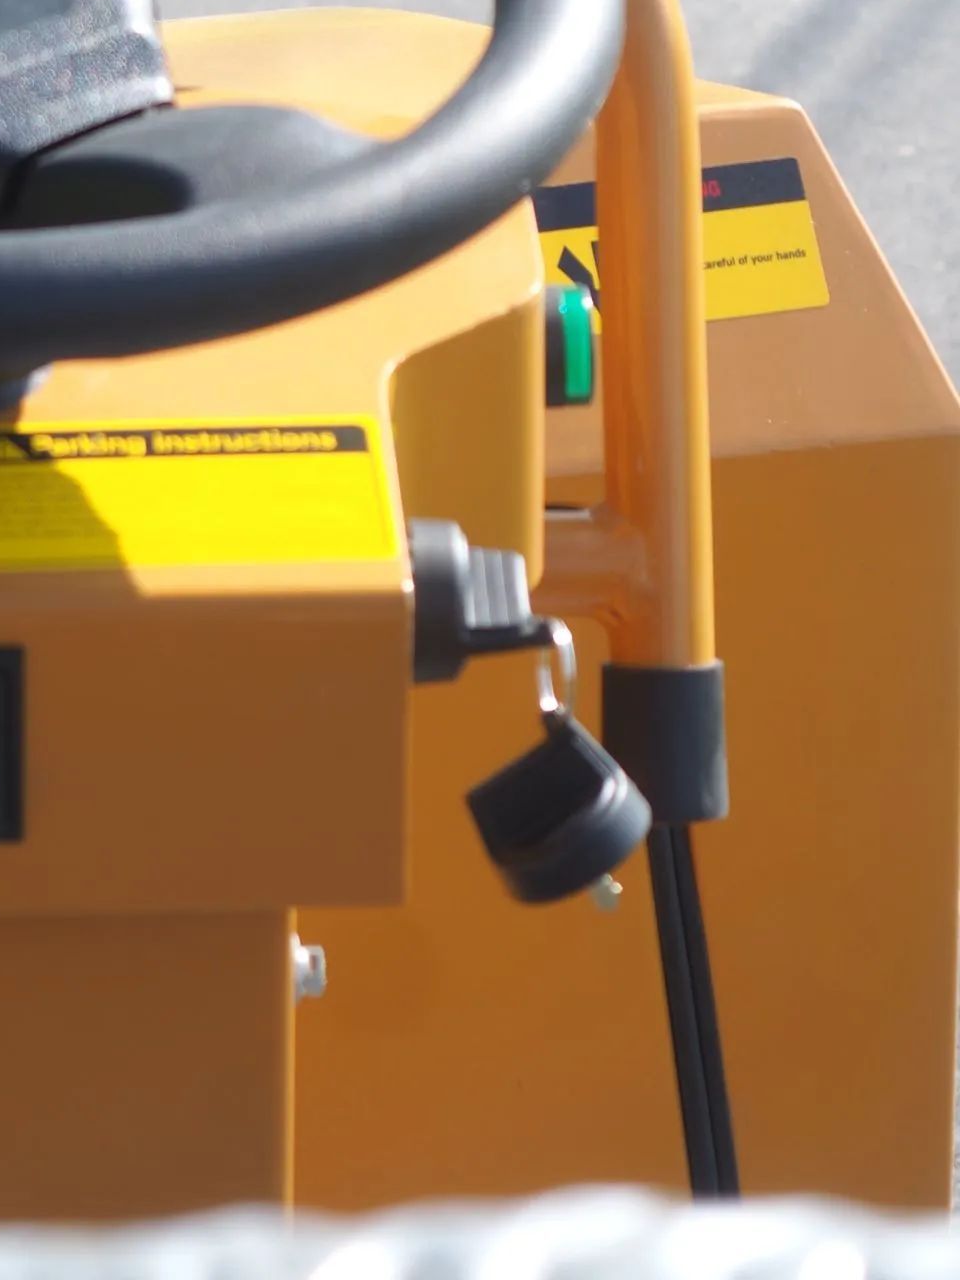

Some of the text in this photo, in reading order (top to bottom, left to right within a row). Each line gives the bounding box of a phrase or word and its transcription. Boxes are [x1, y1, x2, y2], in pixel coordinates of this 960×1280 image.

[738, 254, 748, 266] of
[750, 254, 773, 266] your
[775, 248, 807, 261] hands
[29, 431, 148, 459] Parking
